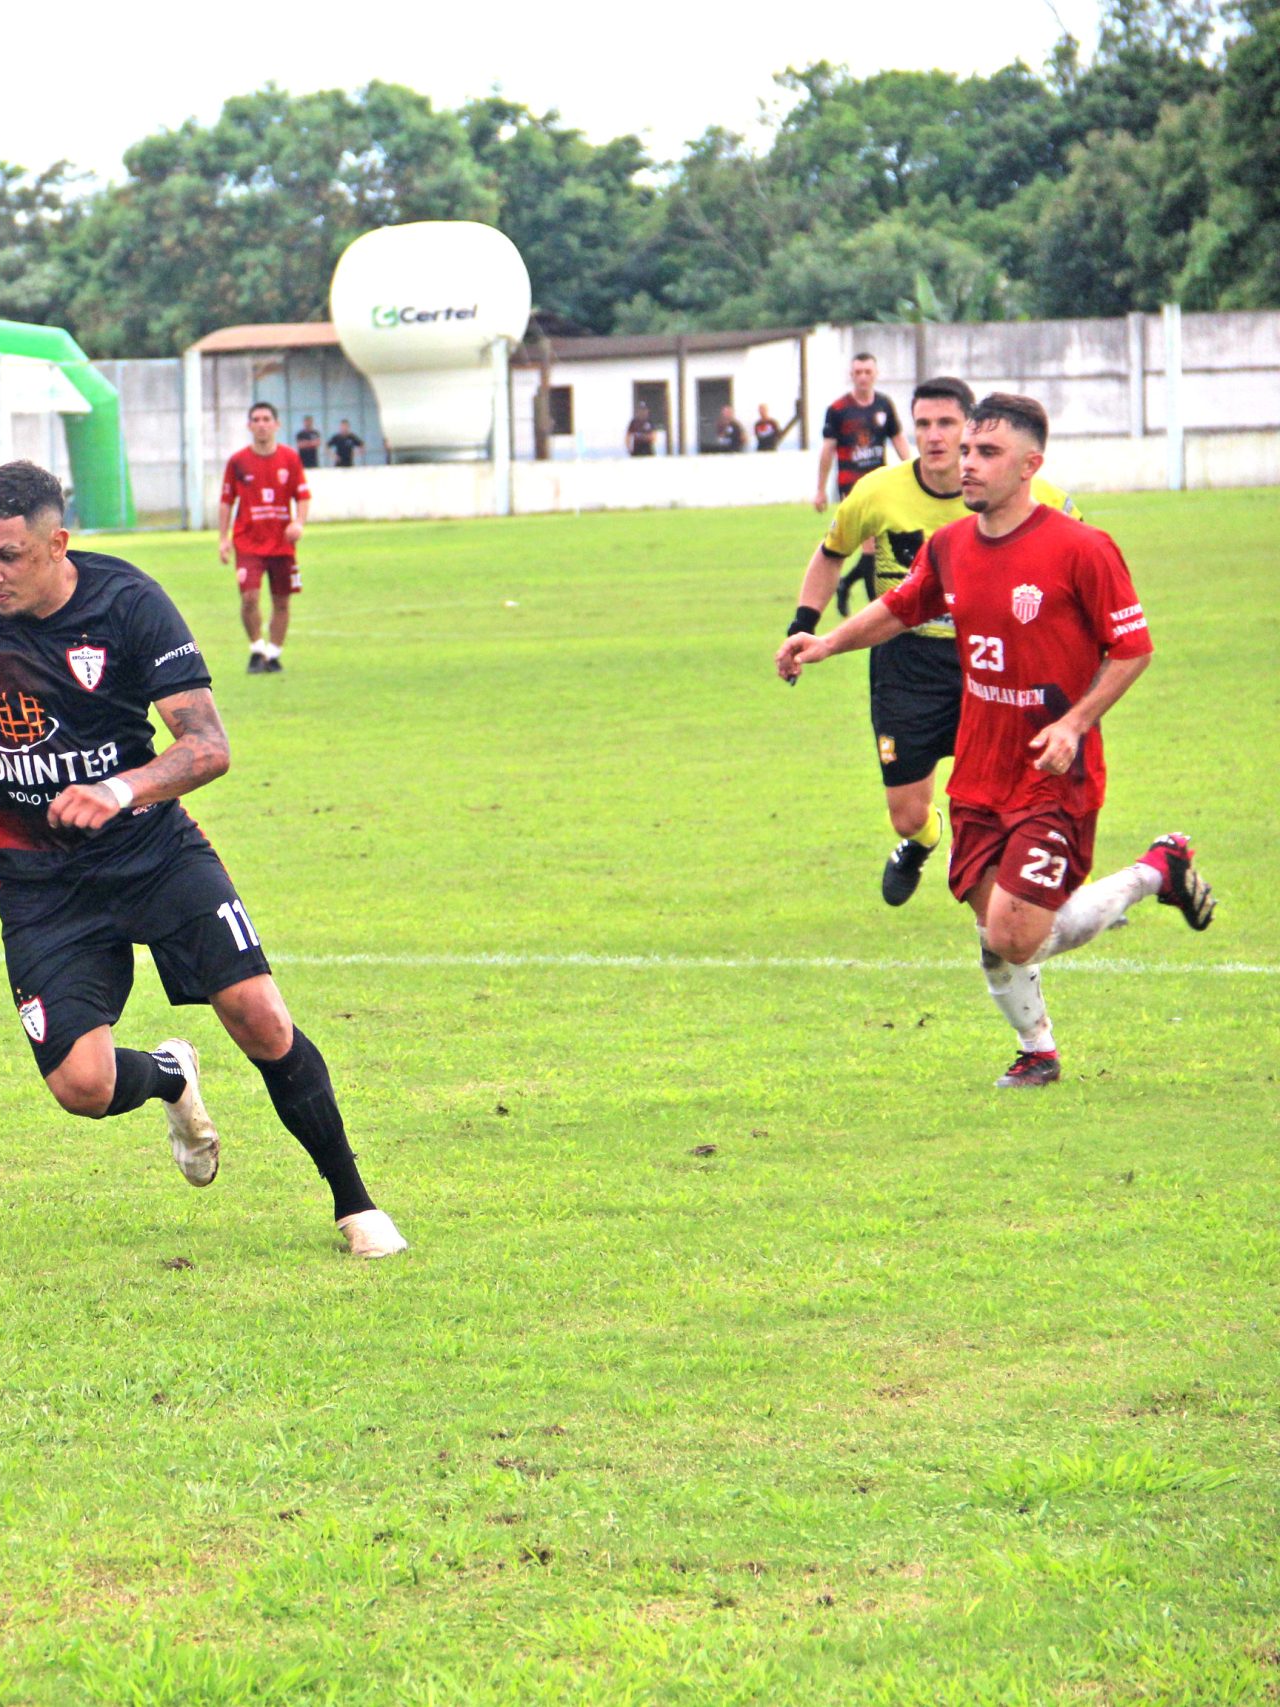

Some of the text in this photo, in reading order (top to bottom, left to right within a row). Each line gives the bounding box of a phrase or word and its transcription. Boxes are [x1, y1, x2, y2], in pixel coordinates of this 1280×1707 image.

[400, 303, 478, 324] Certel
[968, 634, 1006, 673] 23
[1019, 847, 1068, 890] 23
[216, 899, 260, 952] 11
